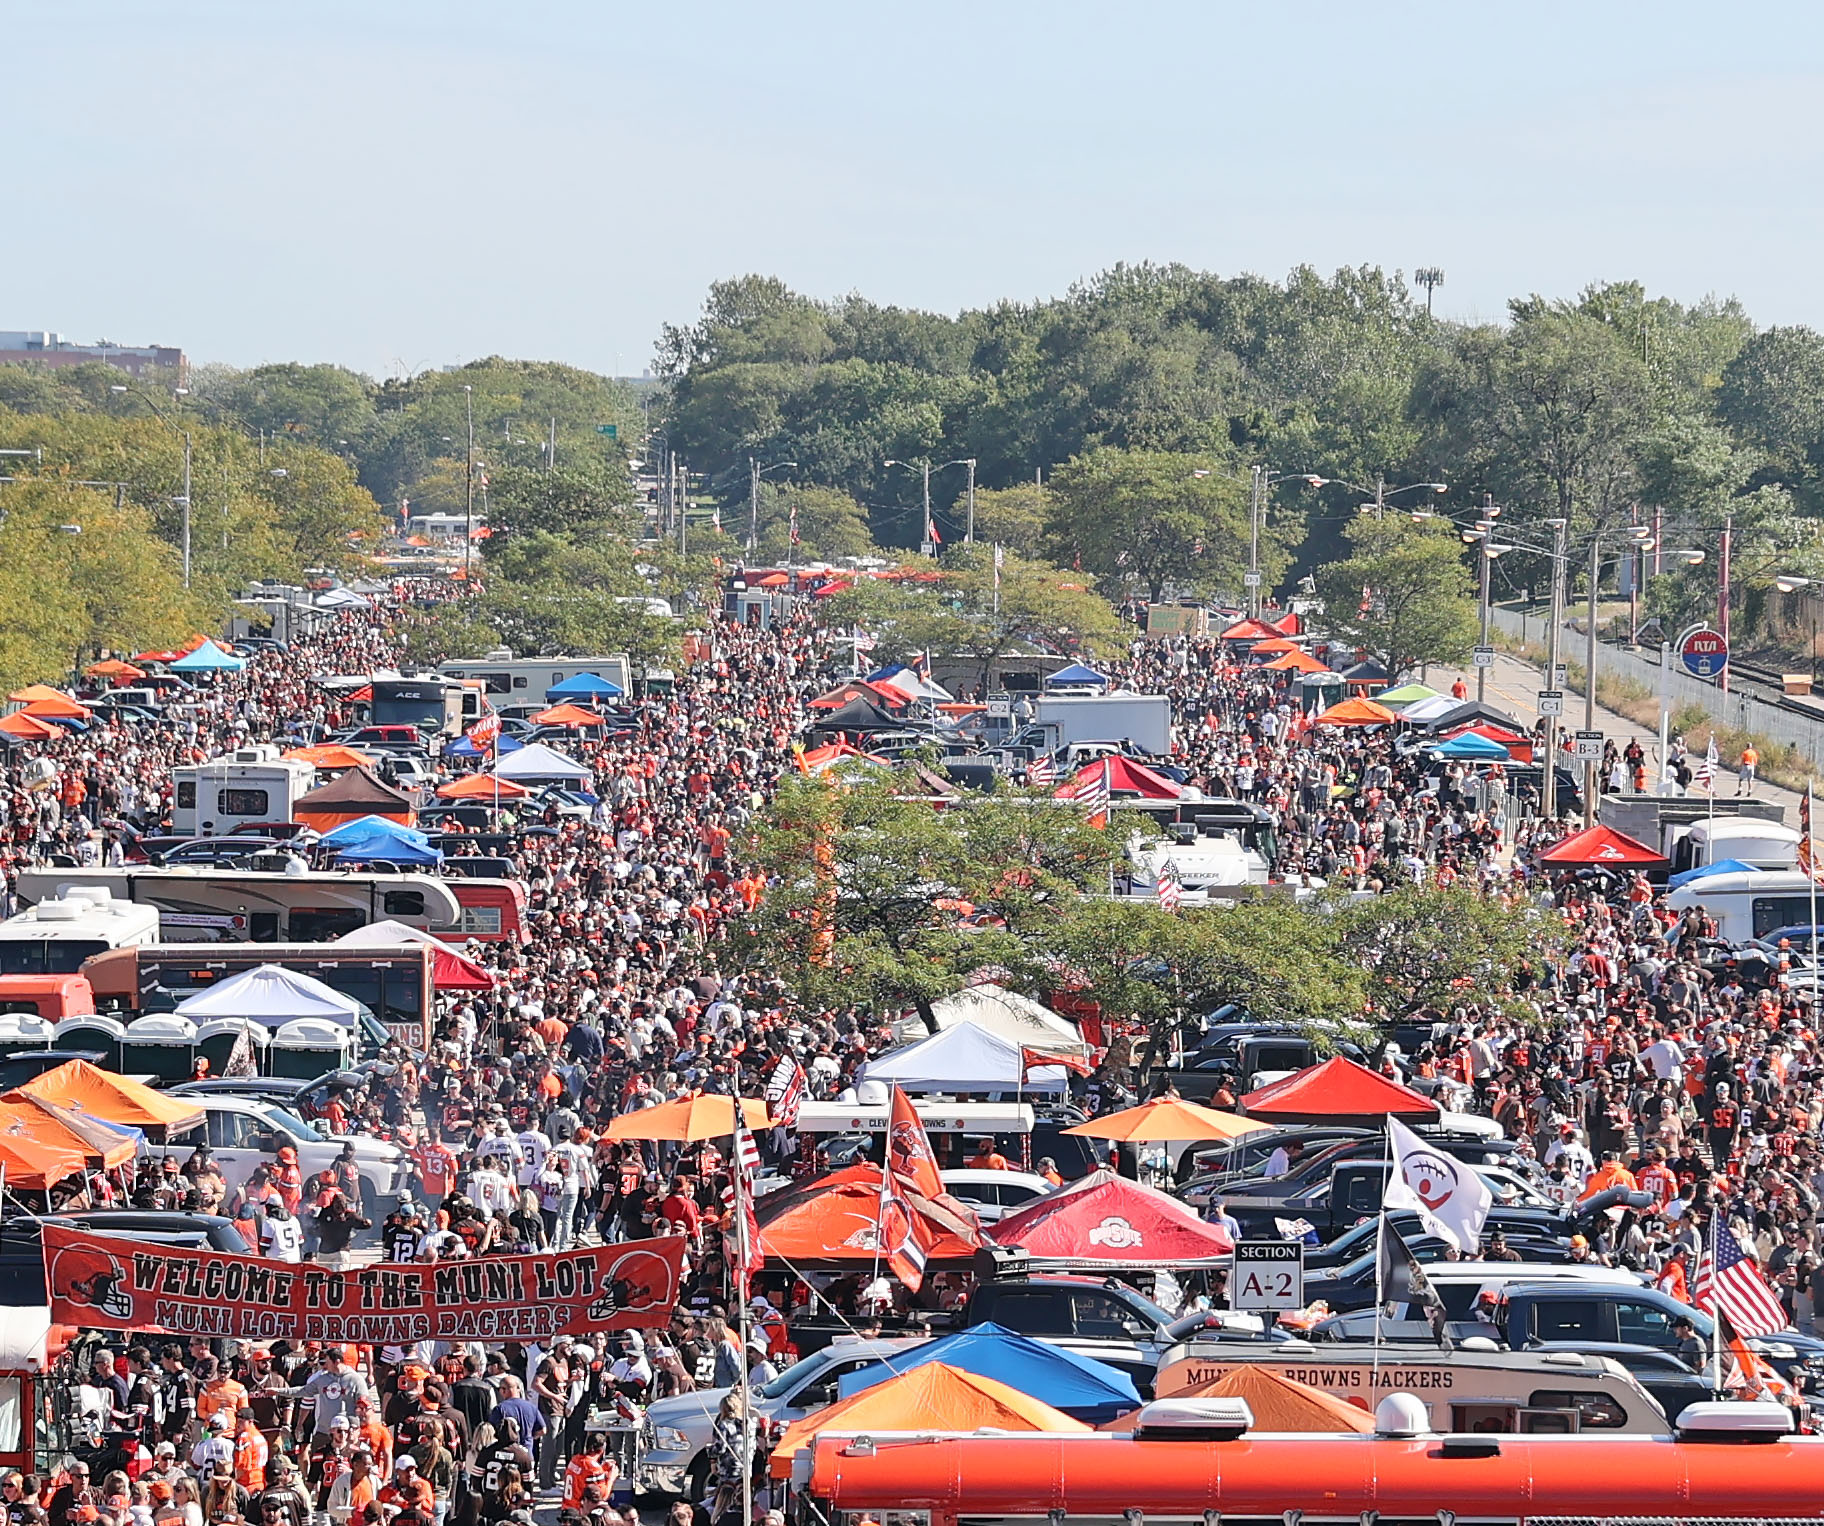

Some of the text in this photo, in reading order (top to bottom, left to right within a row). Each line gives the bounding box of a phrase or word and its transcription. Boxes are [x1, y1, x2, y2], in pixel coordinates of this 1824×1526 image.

[1694, 641, 1717, 651] RTA
[1541, 702, 1559, 711] C-1
[1578, 745, 1599, 755] B-3
[1613, 1060, 1631, 1082] 57
[427, 1159, 443, 1175] 13
[1642, 1176, 1664, 1193] 80
[392, 1240, 414, 1264] 12
[1240, 1245, 1297, 1259] SECTION
[133, 1252, 598, 1309] WELCOME TO THE MUNI LOT
[1241, 1271, 1293, 1298] A-2
[155, 1299, 570, 1341] MUNI LOT BROWNS BACKERS
[1285, 1369, 1361, 1387] BROWNS
